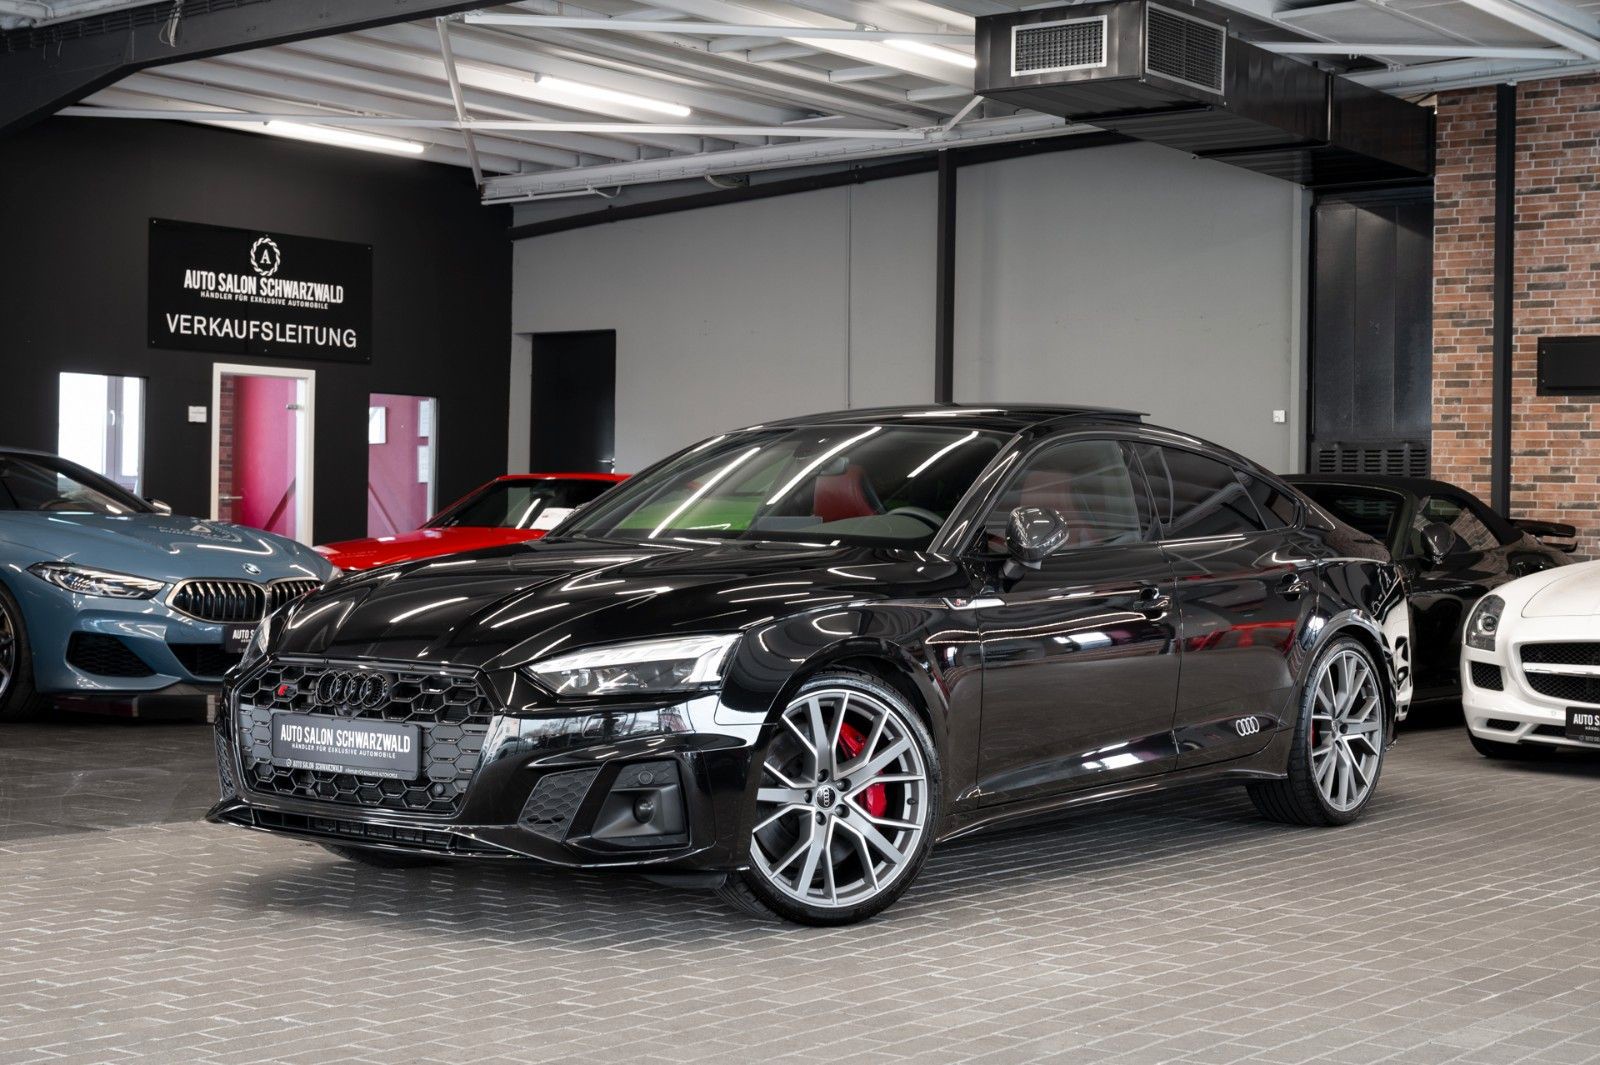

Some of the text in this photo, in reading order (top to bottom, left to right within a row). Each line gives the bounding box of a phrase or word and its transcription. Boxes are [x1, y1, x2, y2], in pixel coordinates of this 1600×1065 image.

[260, 249, 271, 264] A
[183, 269, 344, 304] AUTO SALON SCHWARZWALD
[200, 290, 329, 310] HÄNDLER FÜR EXKLUSIVE AUTOMOBILE
[166, 313, 357, 348] VERKAUFSLEITUNG
[232, 629, 250, 640] AUTO
[1573, 713, 1593, 725] AUTO
[280, 724, 411, 753] AUTO SALON SCHWARZWALD
[359, 749, 397, 759] AUTOMOBILE
